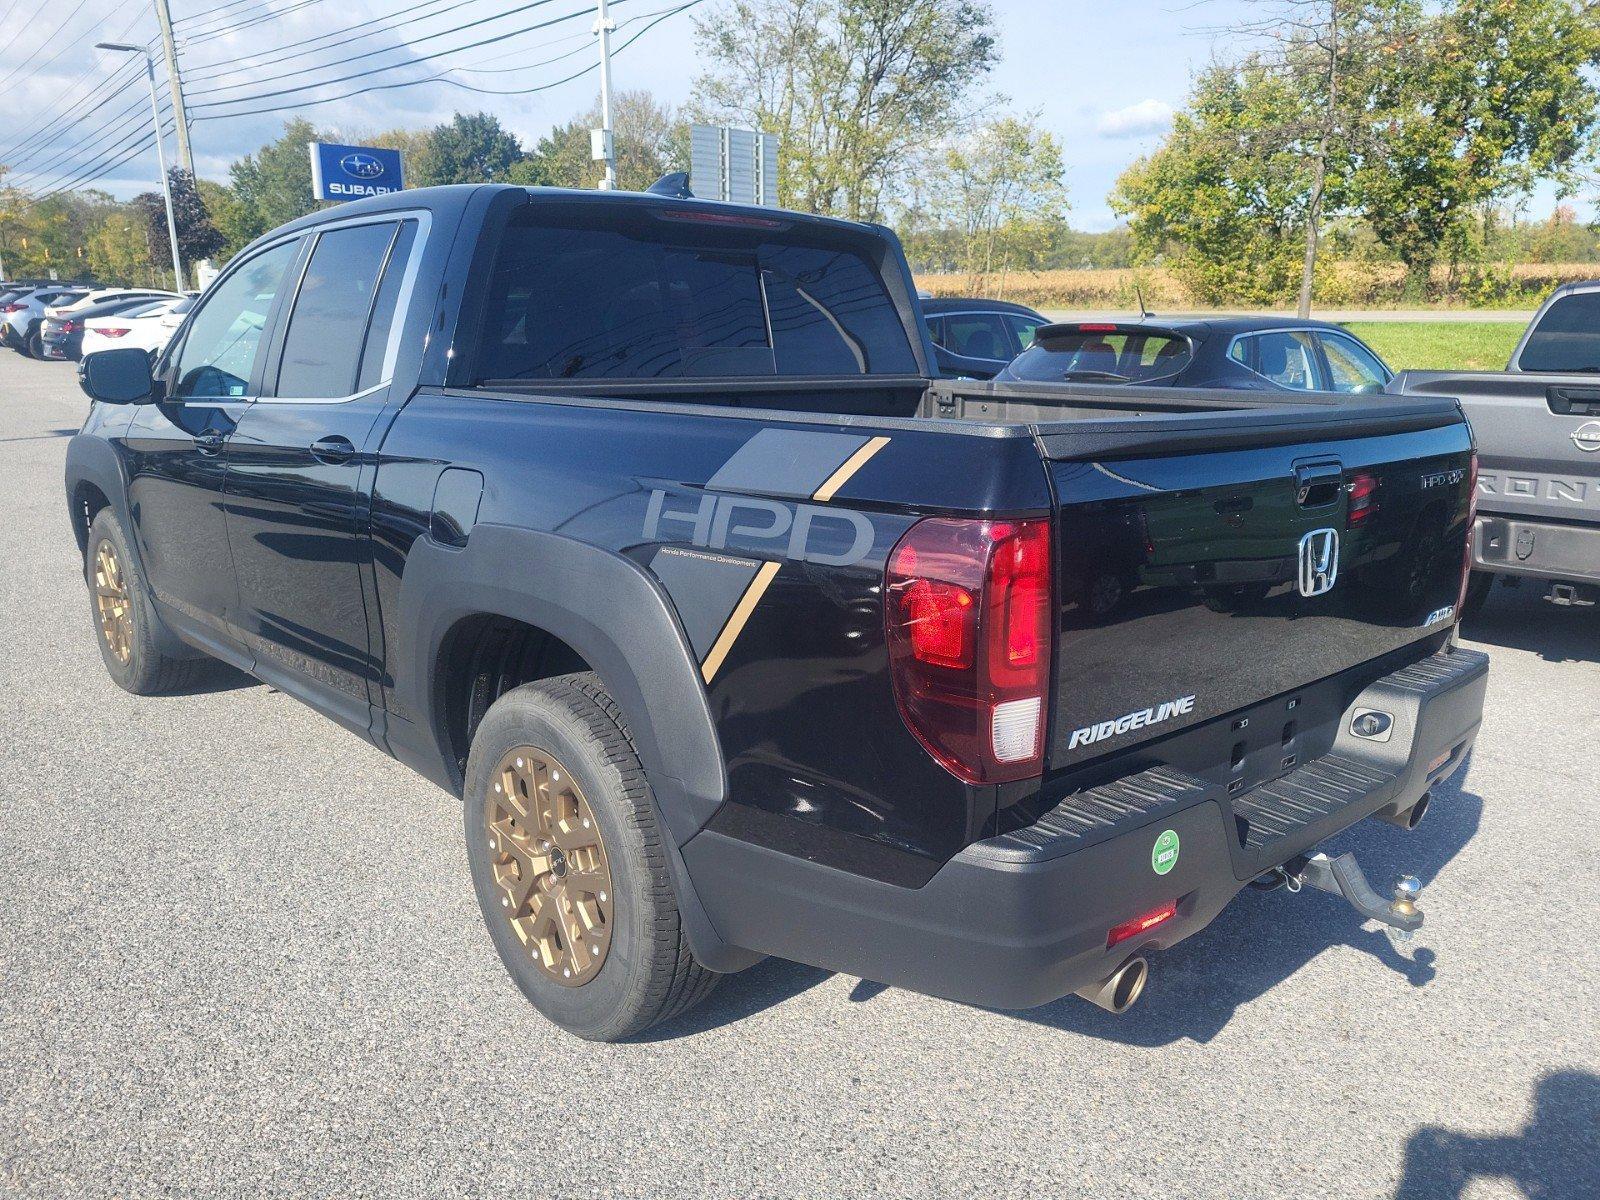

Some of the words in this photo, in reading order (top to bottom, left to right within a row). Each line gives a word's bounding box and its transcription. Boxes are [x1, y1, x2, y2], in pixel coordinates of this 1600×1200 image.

[642, 489, 875, 567] HPD
[661, 547, 679, 556] Honda
[680, 550, 717, 562] Performance
[717, 556, 756, 568] Development
[1068, 694, 1195, 750] RIDGELINE
